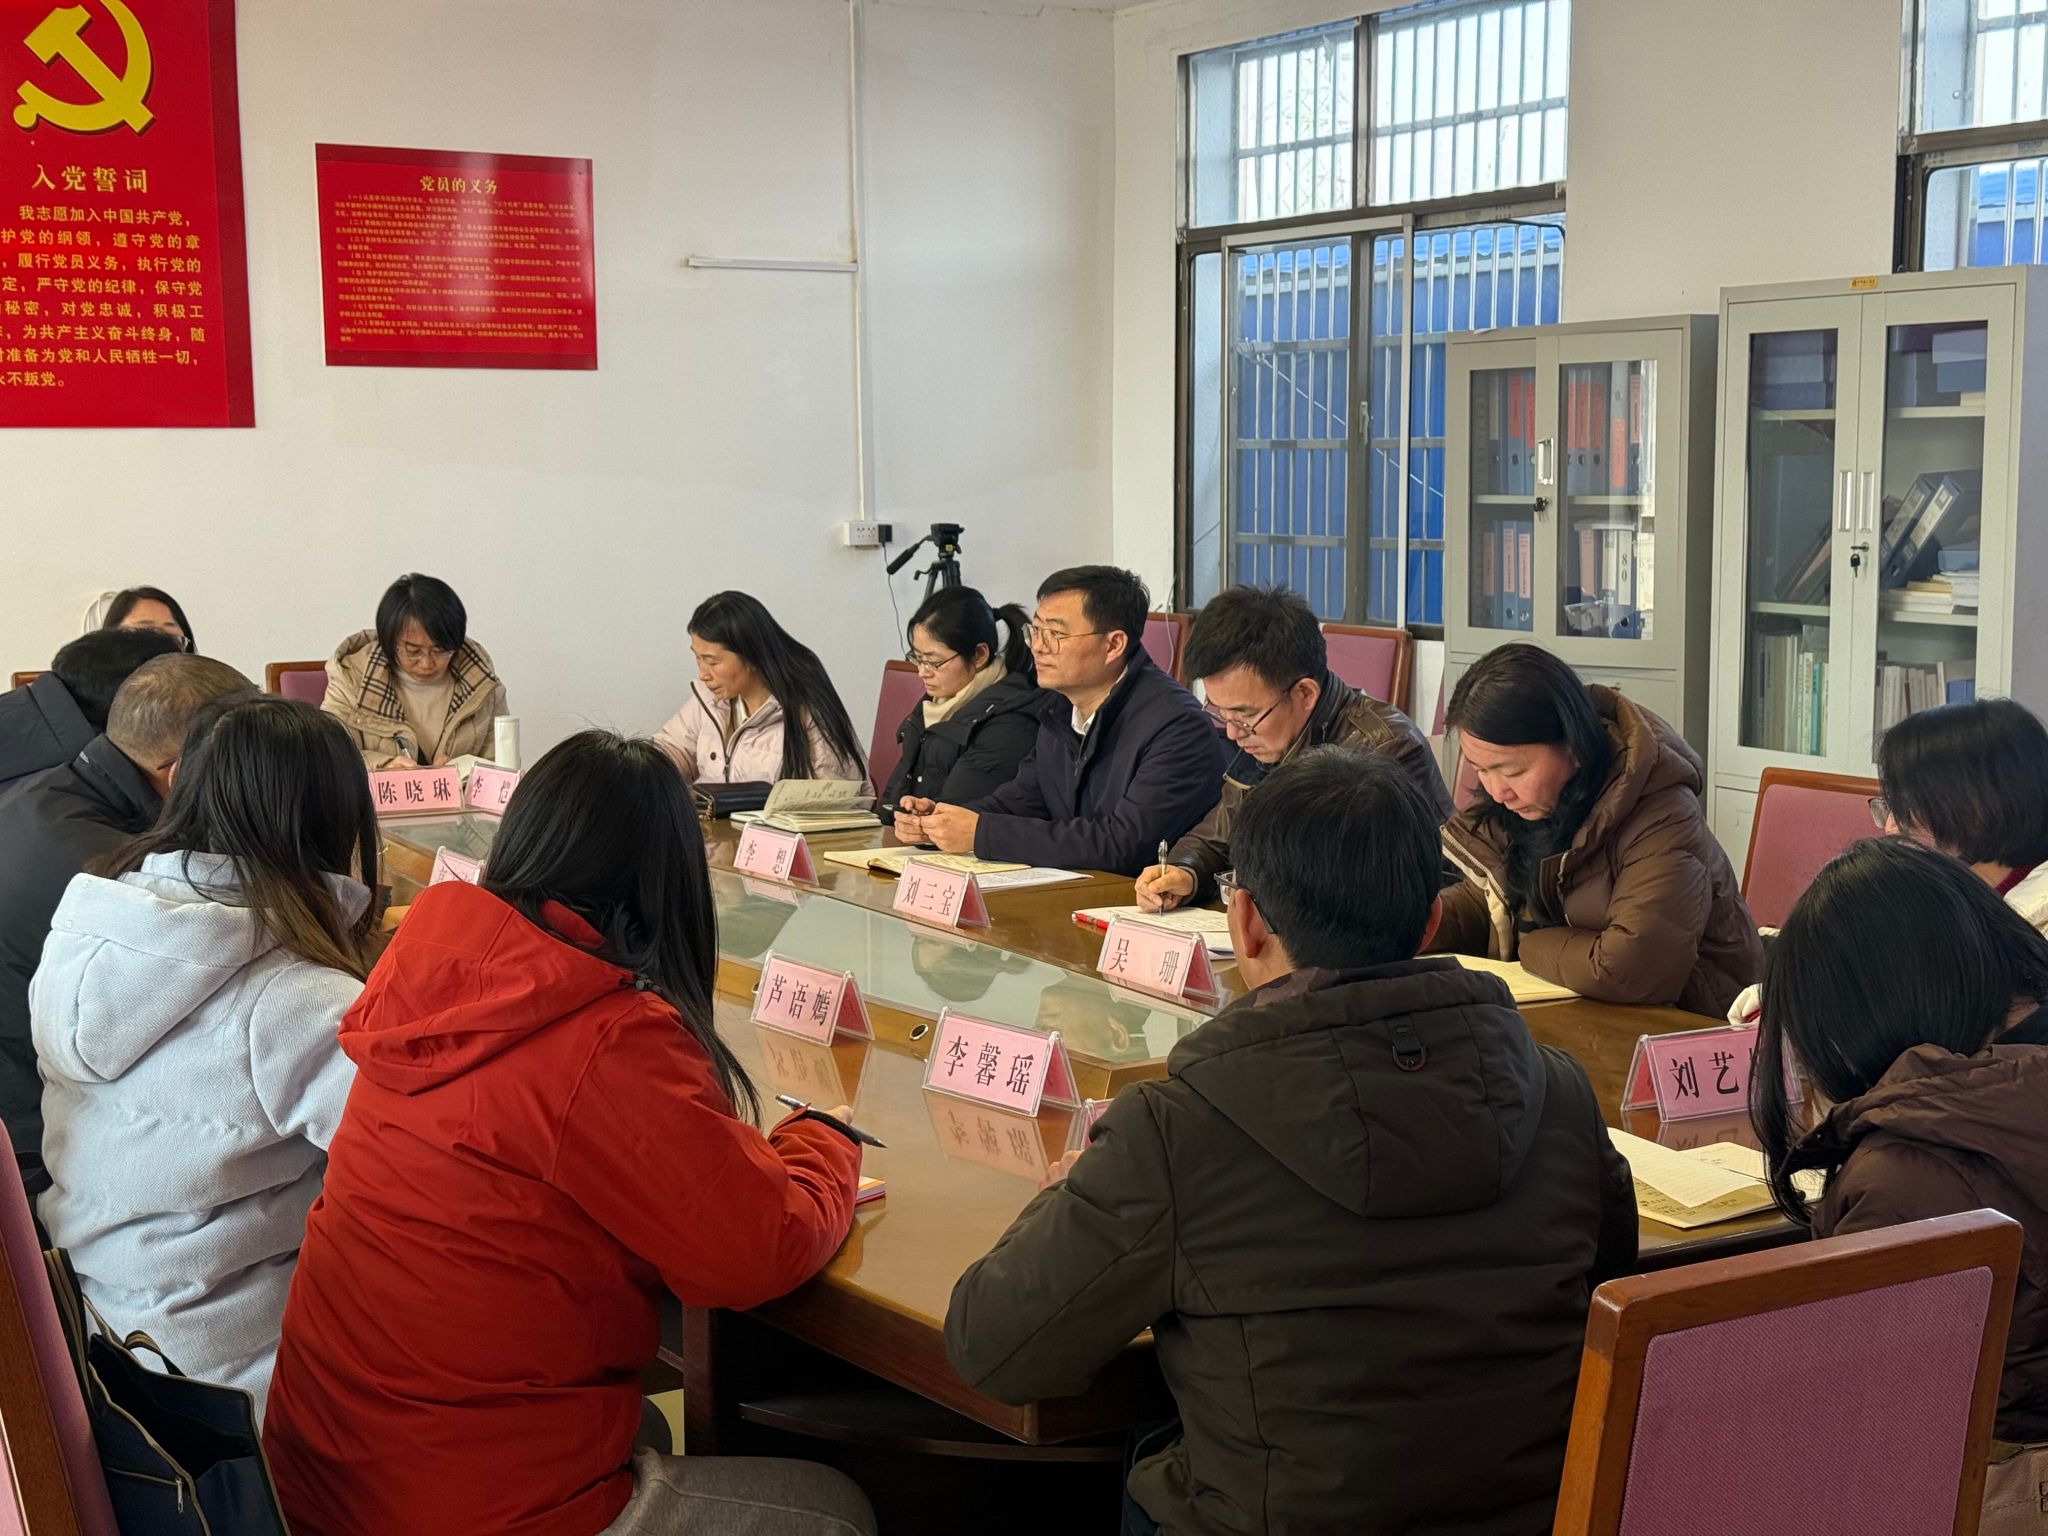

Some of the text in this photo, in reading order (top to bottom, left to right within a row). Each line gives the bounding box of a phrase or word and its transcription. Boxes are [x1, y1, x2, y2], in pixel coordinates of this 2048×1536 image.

[31, 163, 148, 193] 入党誓词
[420, 176, 498, 195] 党员的义务
[19, 205, 191, 226] 我志愿加入中国共产党，
[0, 228, 201, 250] 护党的纲领，遵守党的章
[2, 277, 203, 296] 定，严守党的纪律，保守党
[0, 300, 204, 319] 秘密，对党忠诚，积极工
[0, 324, 205, 342] ，为共产主义奋斗终身，随
[378, 777, 451, 805] 陈晓琳
[744, 839, 787, 874] 李想
[902, 875, 955, 917] 刘三宝
[1109, 937, 1180, 985] 吴珊
[764, 973, 833, 1026] 芦语嫣
[943, 1035, 1035, 1096] 李馨瑶
[1668, 1047, 1756, 1100] 刘艺
